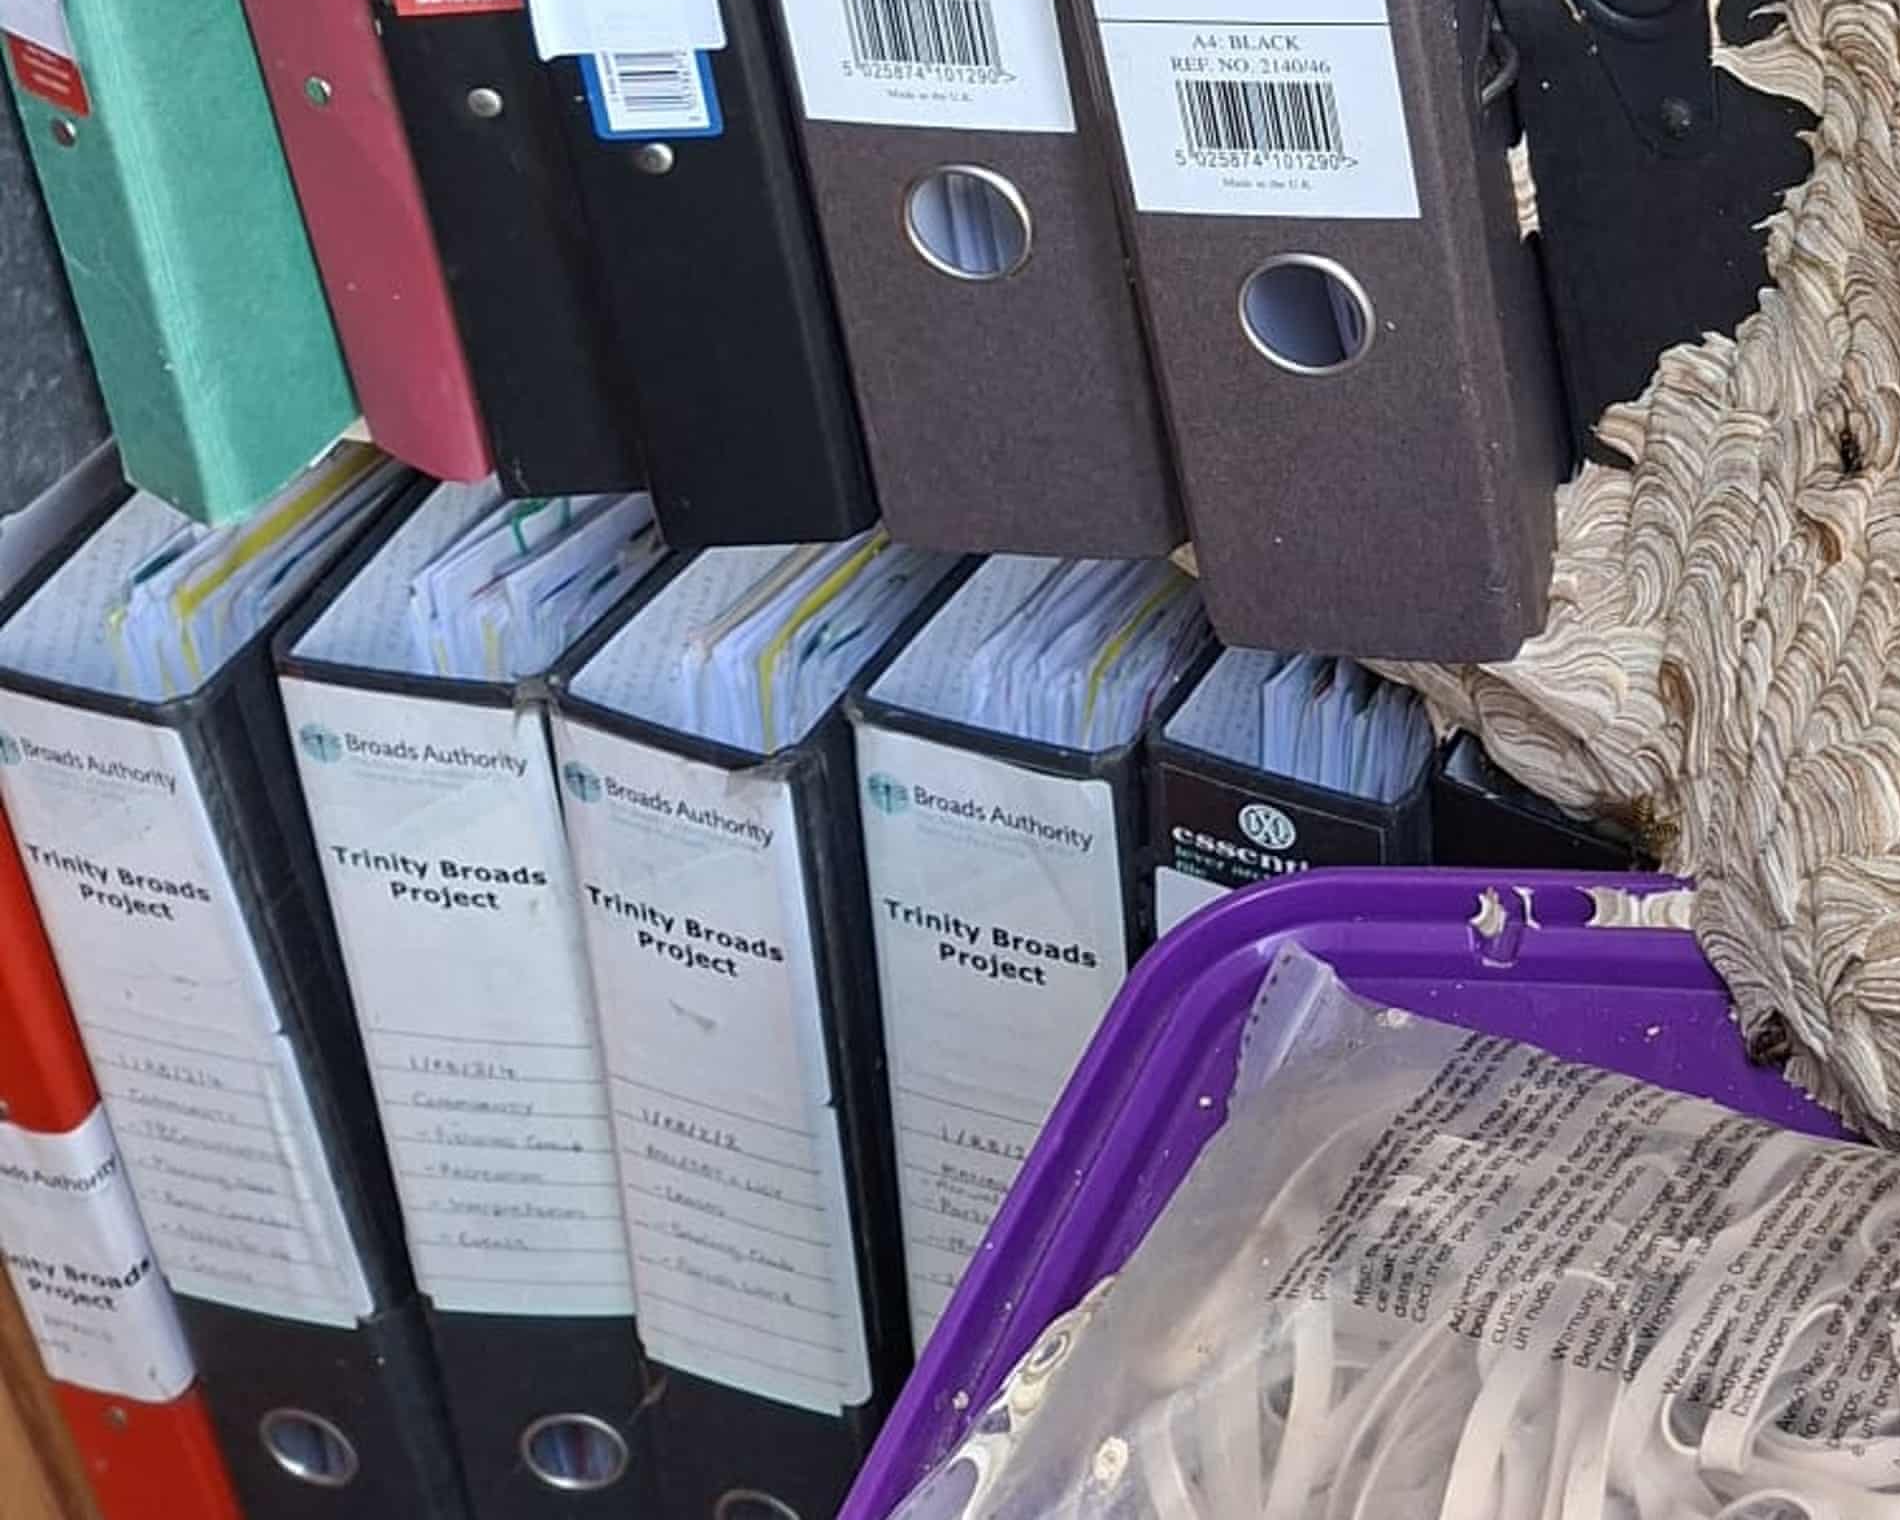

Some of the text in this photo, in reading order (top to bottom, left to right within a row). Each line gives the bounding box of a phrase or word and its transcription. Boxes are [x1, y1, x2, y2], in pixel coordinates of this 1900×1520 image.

[1229, 34, 1301, 51] BLACK
[20, 736, 176, 796] Broads Authority
[344, 733, 527, 777] Broads Authority
[605, 777, 774, 848] Broads Authority
[913, 785, 1093, 852] Broads Authority
[24, 843, 211, 902] Trinity Broads
[331, 846, 548, 885] Trinity Broads
[79, 883, 174, 920] Project
[390, 881, 500, 909] Project
[585, 884, 784, 962] Trinity Broads
[884, 898, 1098, 967] Trinity Broads
[638, 930, 737, 977] Project
[939, 943, 1047, 986] Project
